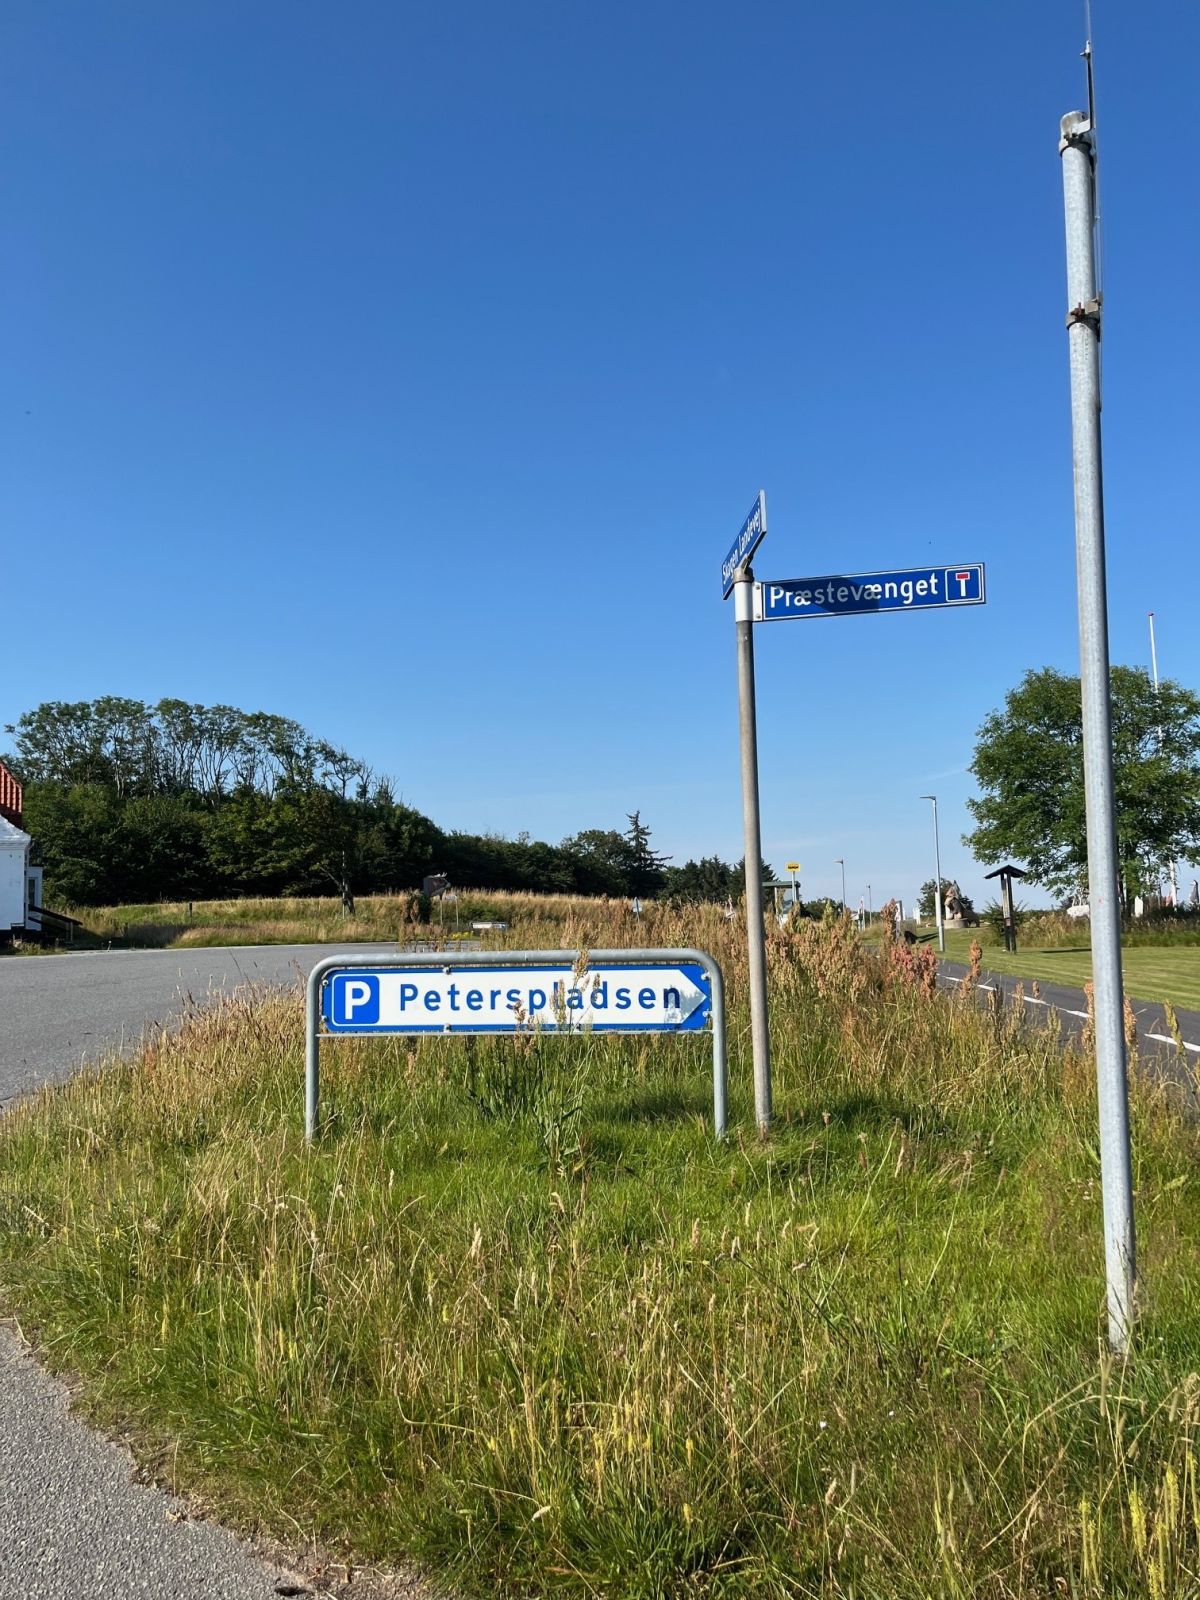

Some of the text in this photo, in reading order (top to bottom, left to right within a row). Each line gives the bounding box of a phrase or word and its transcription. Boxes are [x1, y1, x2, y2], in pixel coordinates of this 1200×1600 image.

[739, 501, 761, 558] Landevej
[770, 572, 938, 609] Præstevænget
[344, 980, 681, 1020] P Peterspladsen
